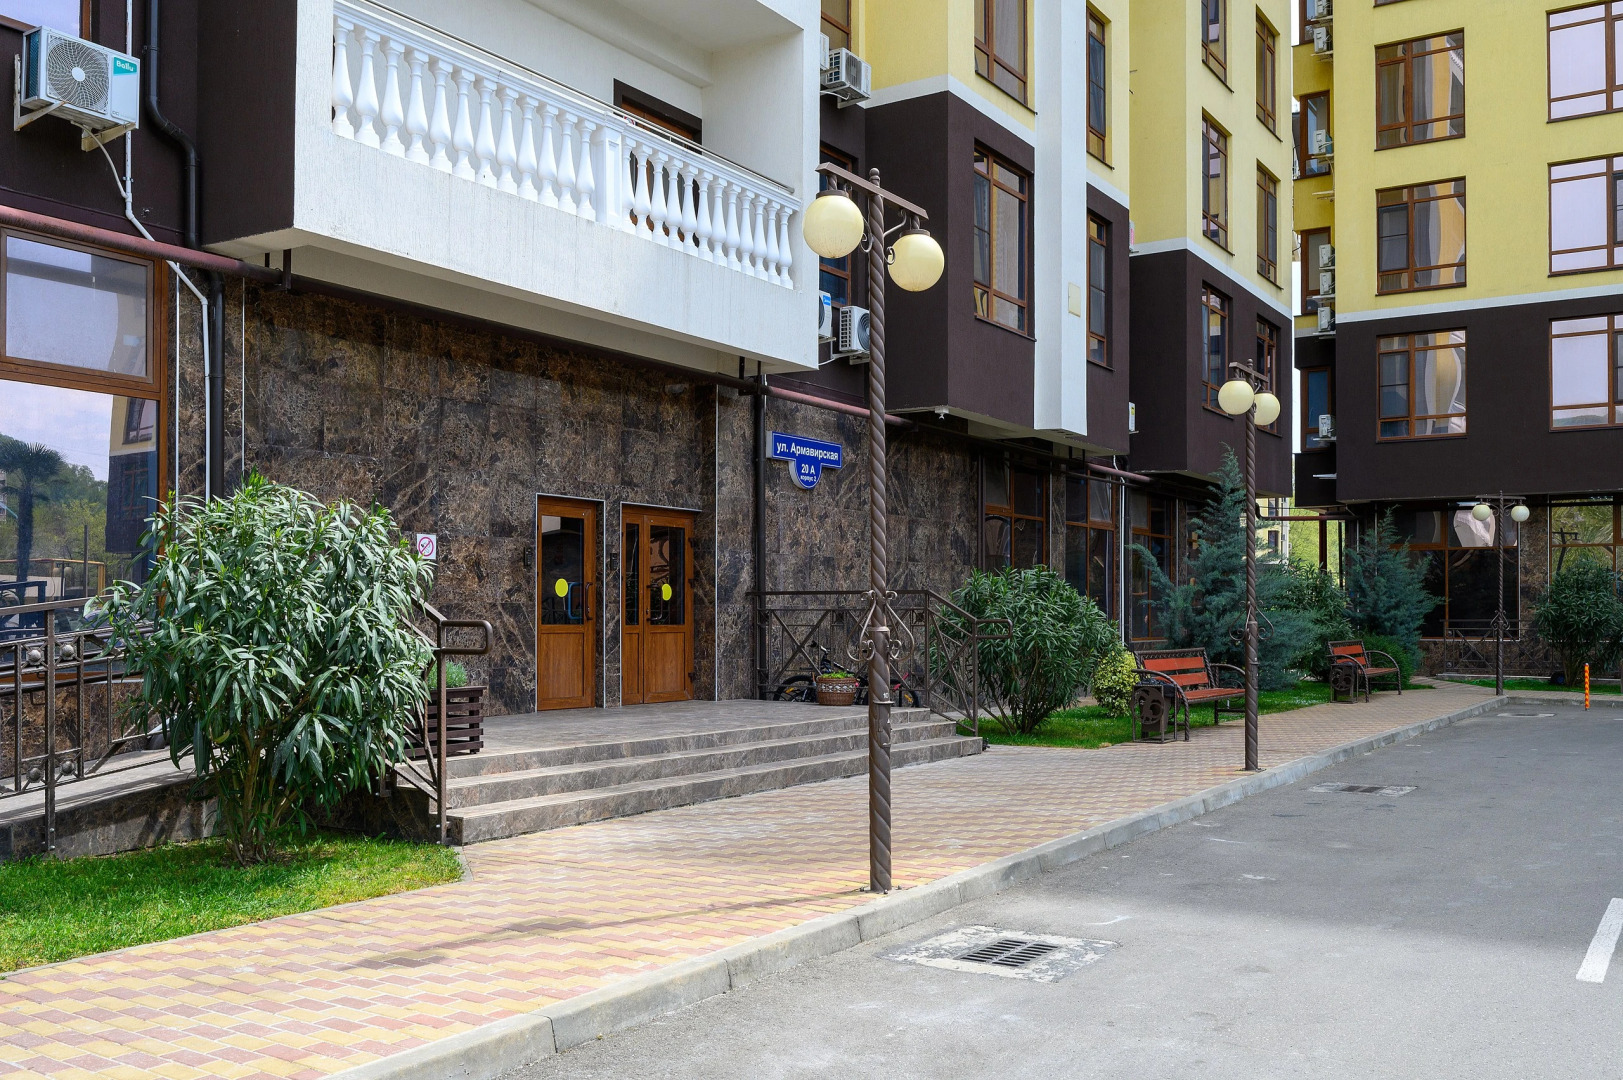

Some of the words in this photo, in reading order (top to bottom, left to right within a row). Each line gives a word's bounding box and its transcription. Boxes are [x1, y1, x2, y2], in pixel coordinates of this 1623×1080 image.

[116, 60, 134, 72] Ballu
[776, 442, 789, 454] ул.
[790, 442, 839, 461] Армавирская
[801, 463, 809, 474] 20
